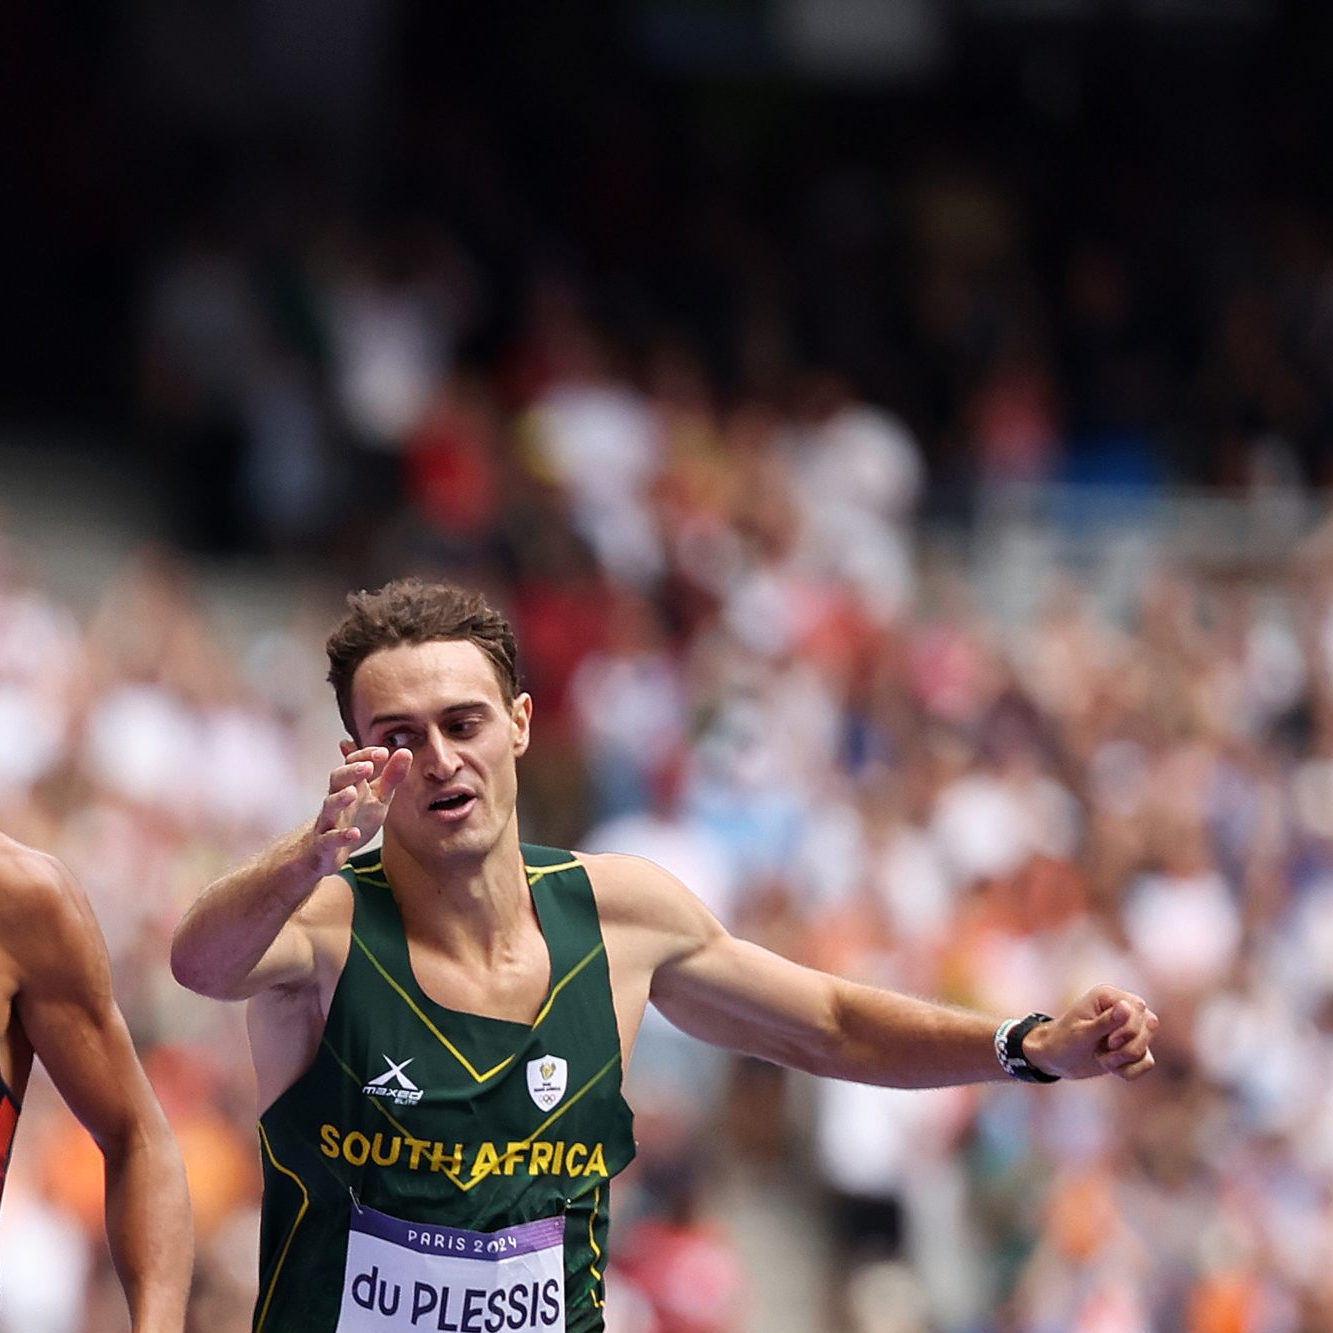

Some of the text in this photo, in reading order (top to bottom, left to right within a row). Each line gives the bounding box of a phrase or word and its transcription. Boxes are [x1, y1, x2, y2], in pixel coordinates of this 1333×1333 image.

[362, 1086, 424, 1101] maxed
[320, 1123, 609, 1178] SOUTH AFRICA
[408, 1229, 518, 1254] PARIS 2024
[351, 1266, 560, 1333] du PLESSIS
